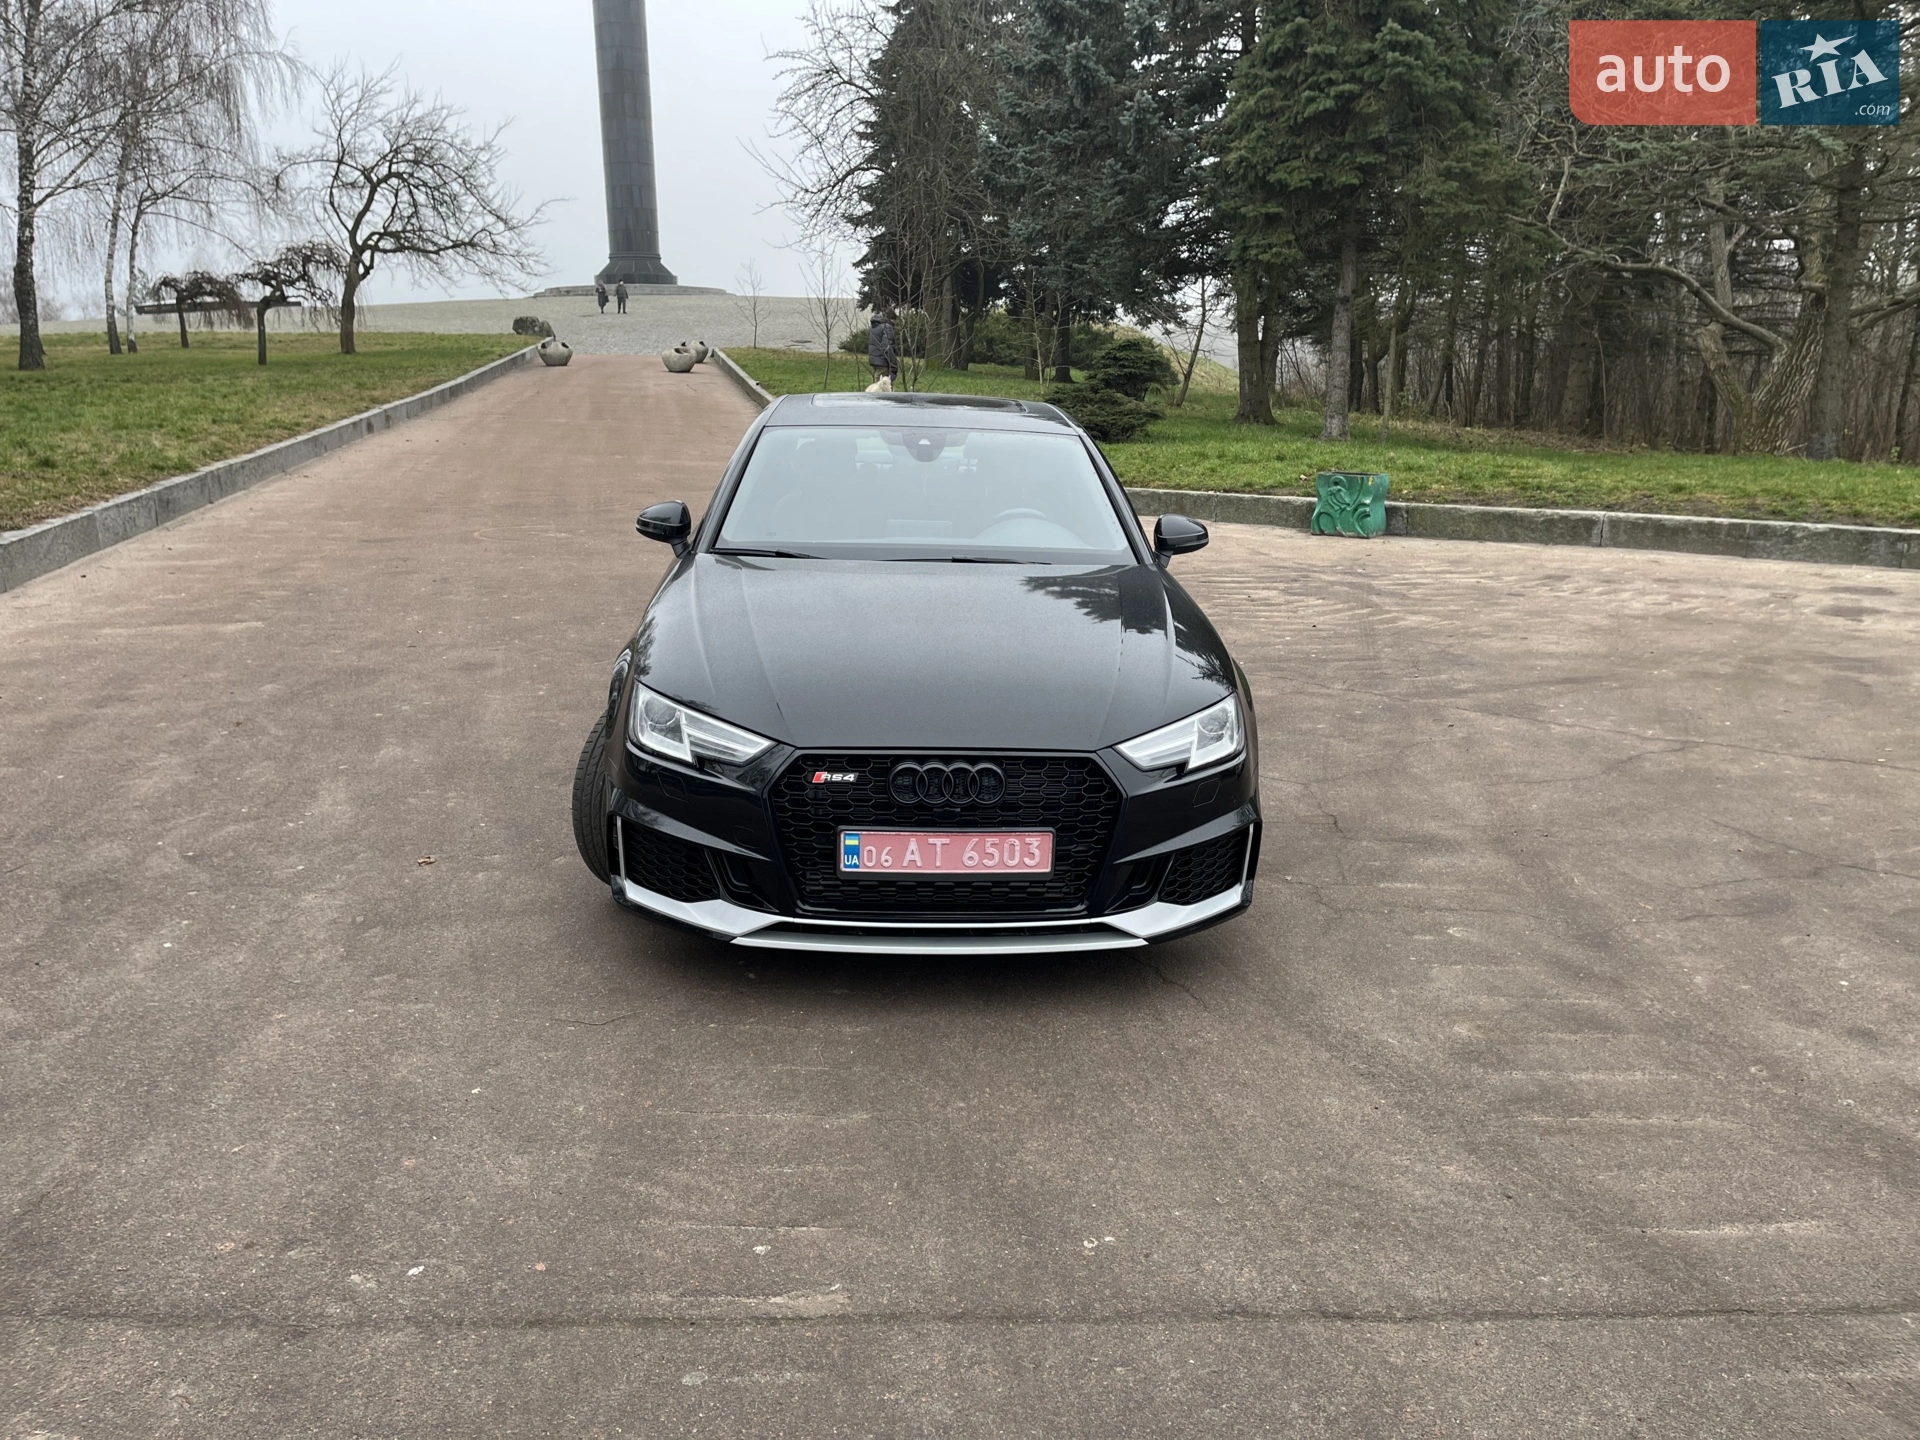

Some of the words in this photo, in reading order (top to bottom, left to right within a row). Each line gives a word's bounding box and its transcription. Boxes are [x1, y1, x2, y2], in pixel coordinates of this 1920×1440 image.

[821, 773, 855, 782] RS4
[863, 845, 893, 868] 06
[902, 837, 951, 868] AT
[961, 837, 1042, 868] 6503
[844, 854, 860, 866] UA
